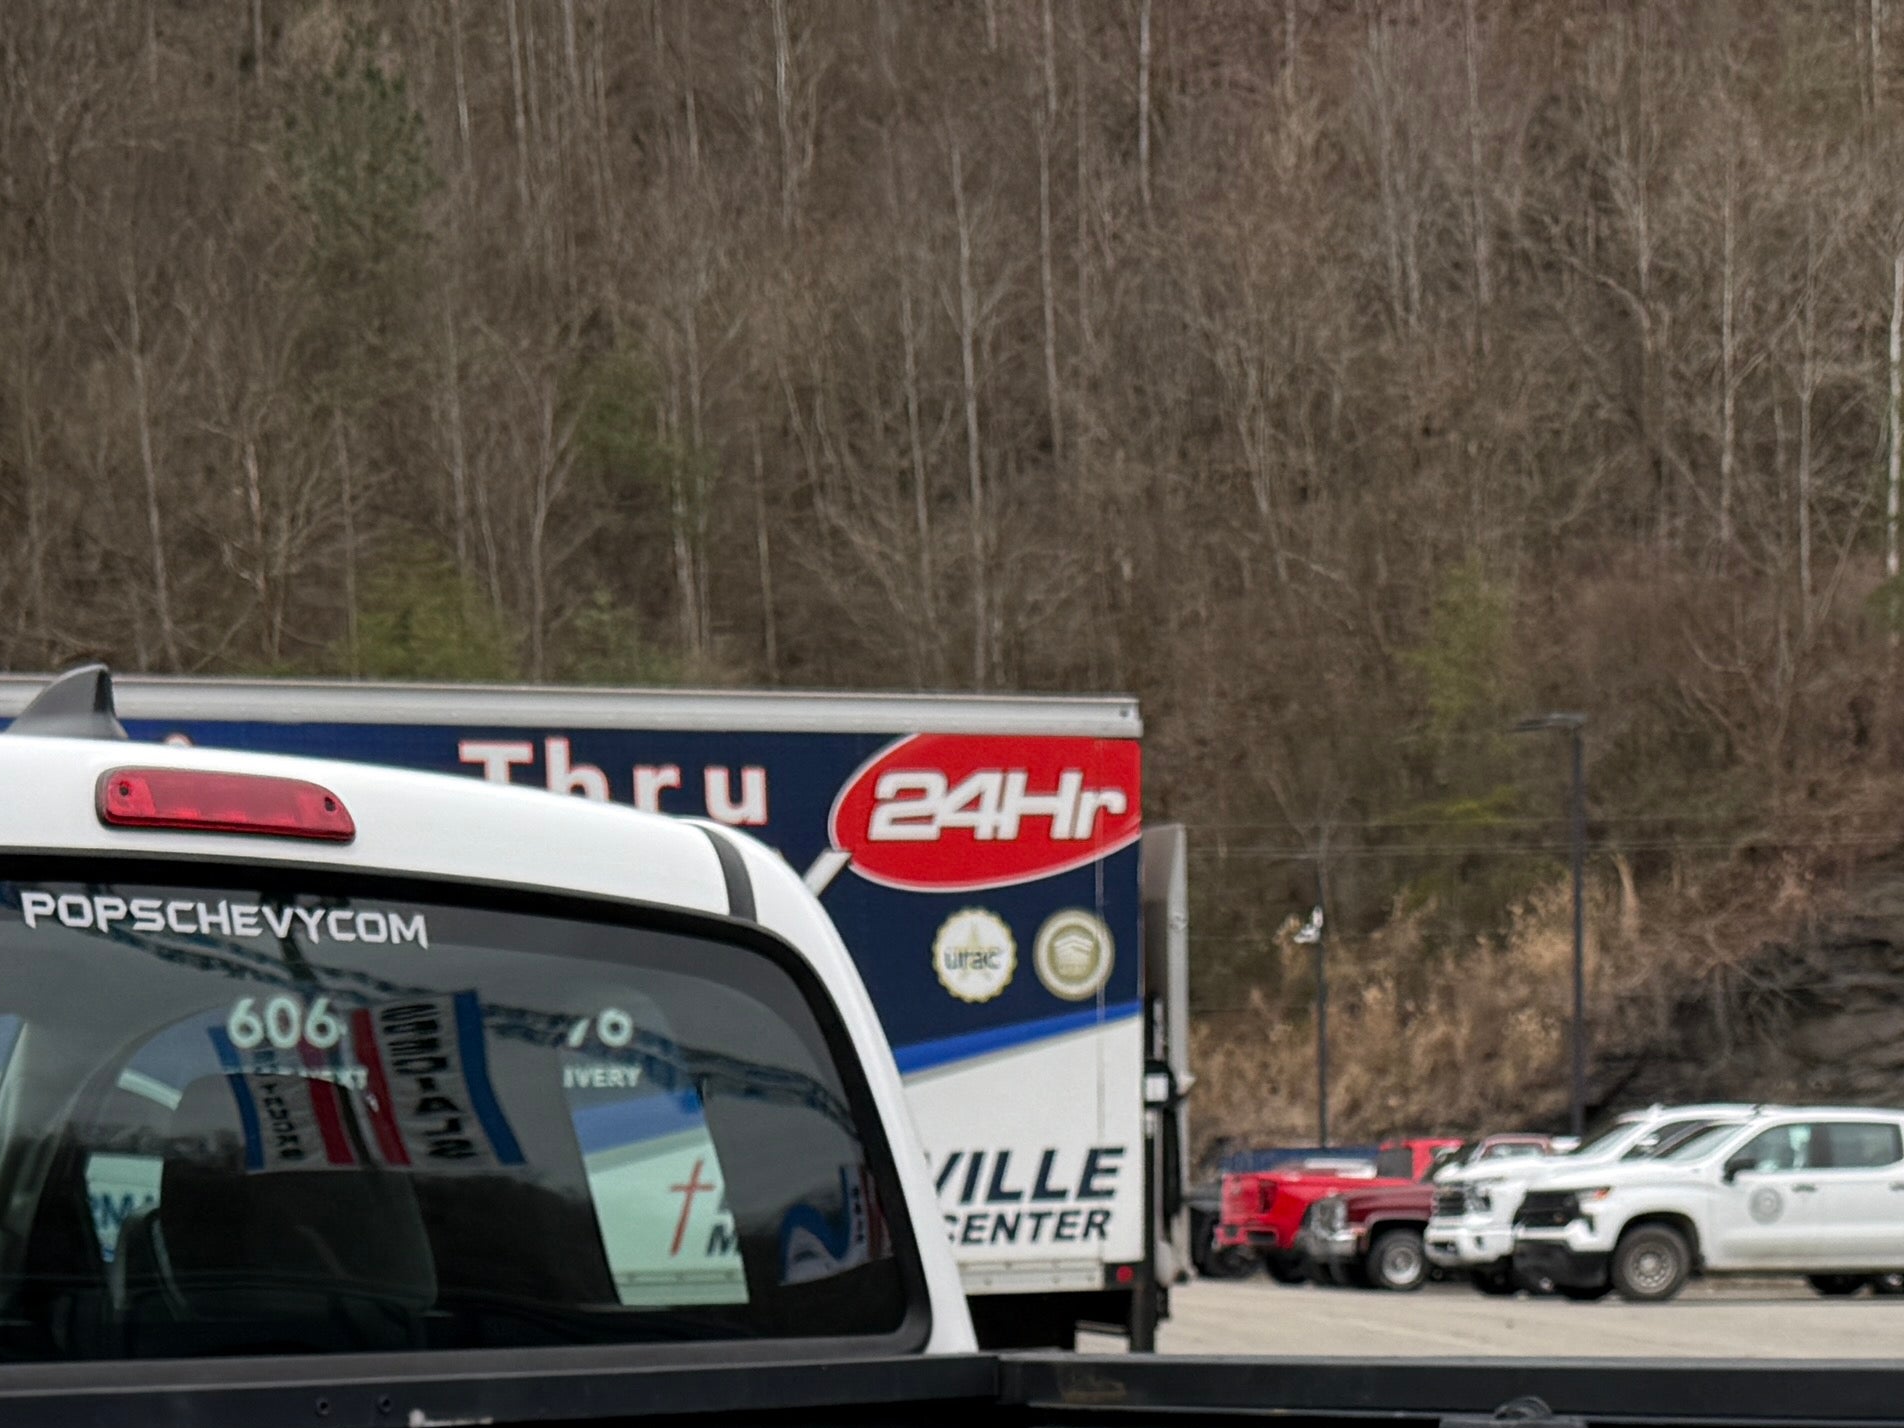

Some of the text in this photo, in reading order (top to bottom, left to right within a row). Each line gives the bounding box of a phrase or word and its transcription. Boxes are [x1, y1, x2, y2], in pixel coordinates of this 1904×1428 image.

[457, 735, 769, 827] Thru
[867, 767, 1128, 841] 24Hr
[228, 997, 342, 1050] 606
